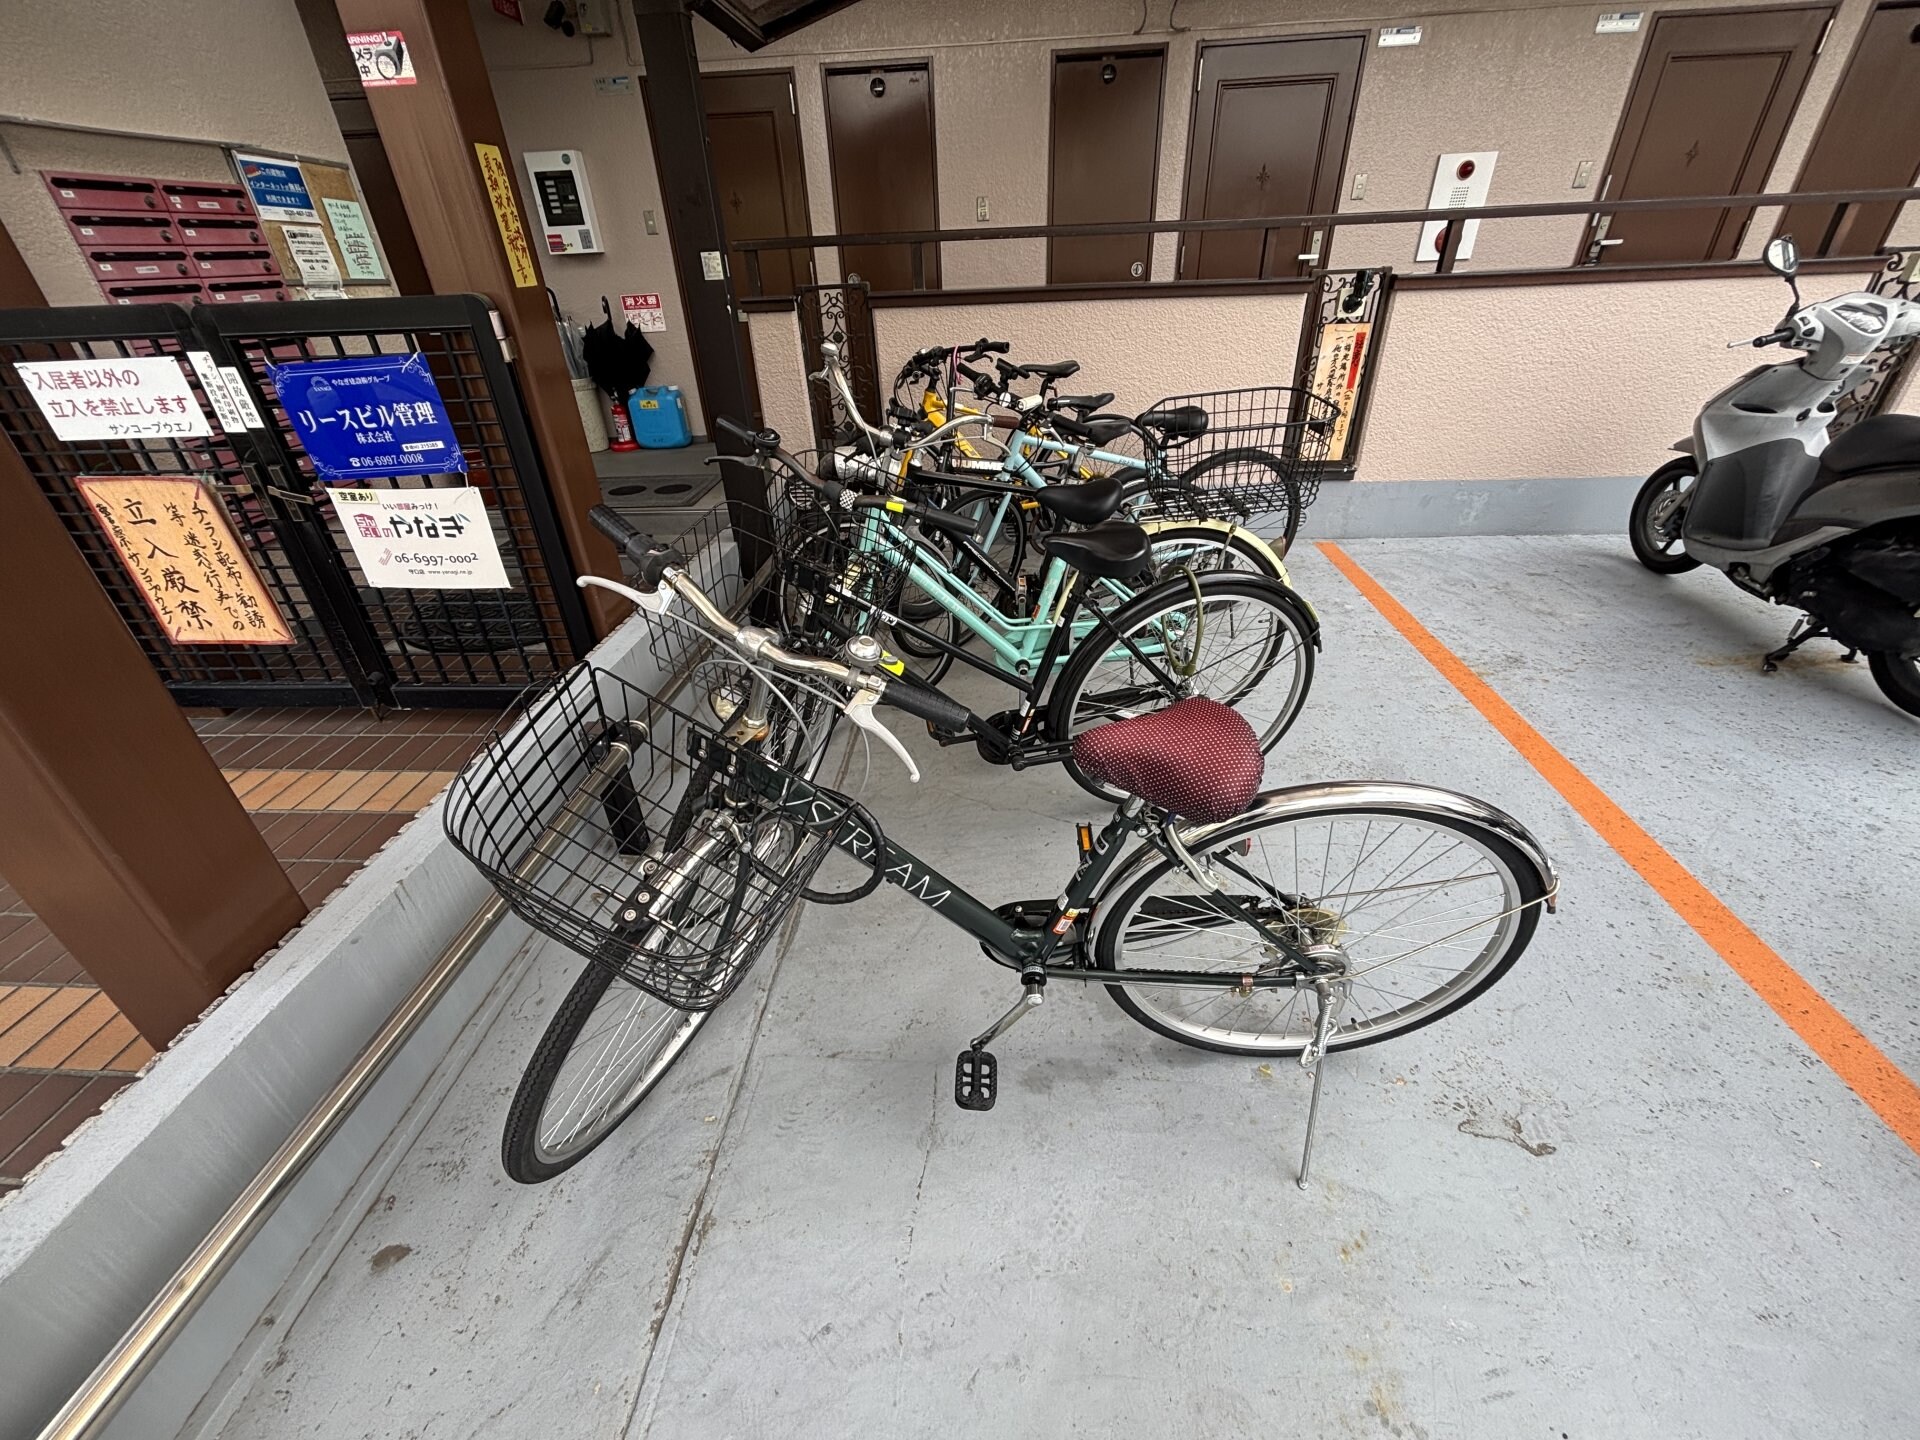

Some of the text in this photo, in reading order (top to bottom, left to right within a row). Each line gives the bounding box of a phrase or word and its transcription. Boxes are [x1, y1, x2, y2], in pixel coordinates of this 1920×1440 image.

[360, 64, 370, 77] 中
[625, 295, 657, 306] 消火器
[32, 368, 140, 391] 入居者以外の
[47, 394, 188, 418] 立入を禁止します
[297, 401, 438, 433] リースビル管理
[355, 430, 395, 444] 株式会社
[360, 453, 424, 467] 06-6997-0008
[338, 491, 374, 501] 空室あり
[122, 498, 213, 630] 立入厳禁
[394, 552, 479, 566] 06-6997-0002
